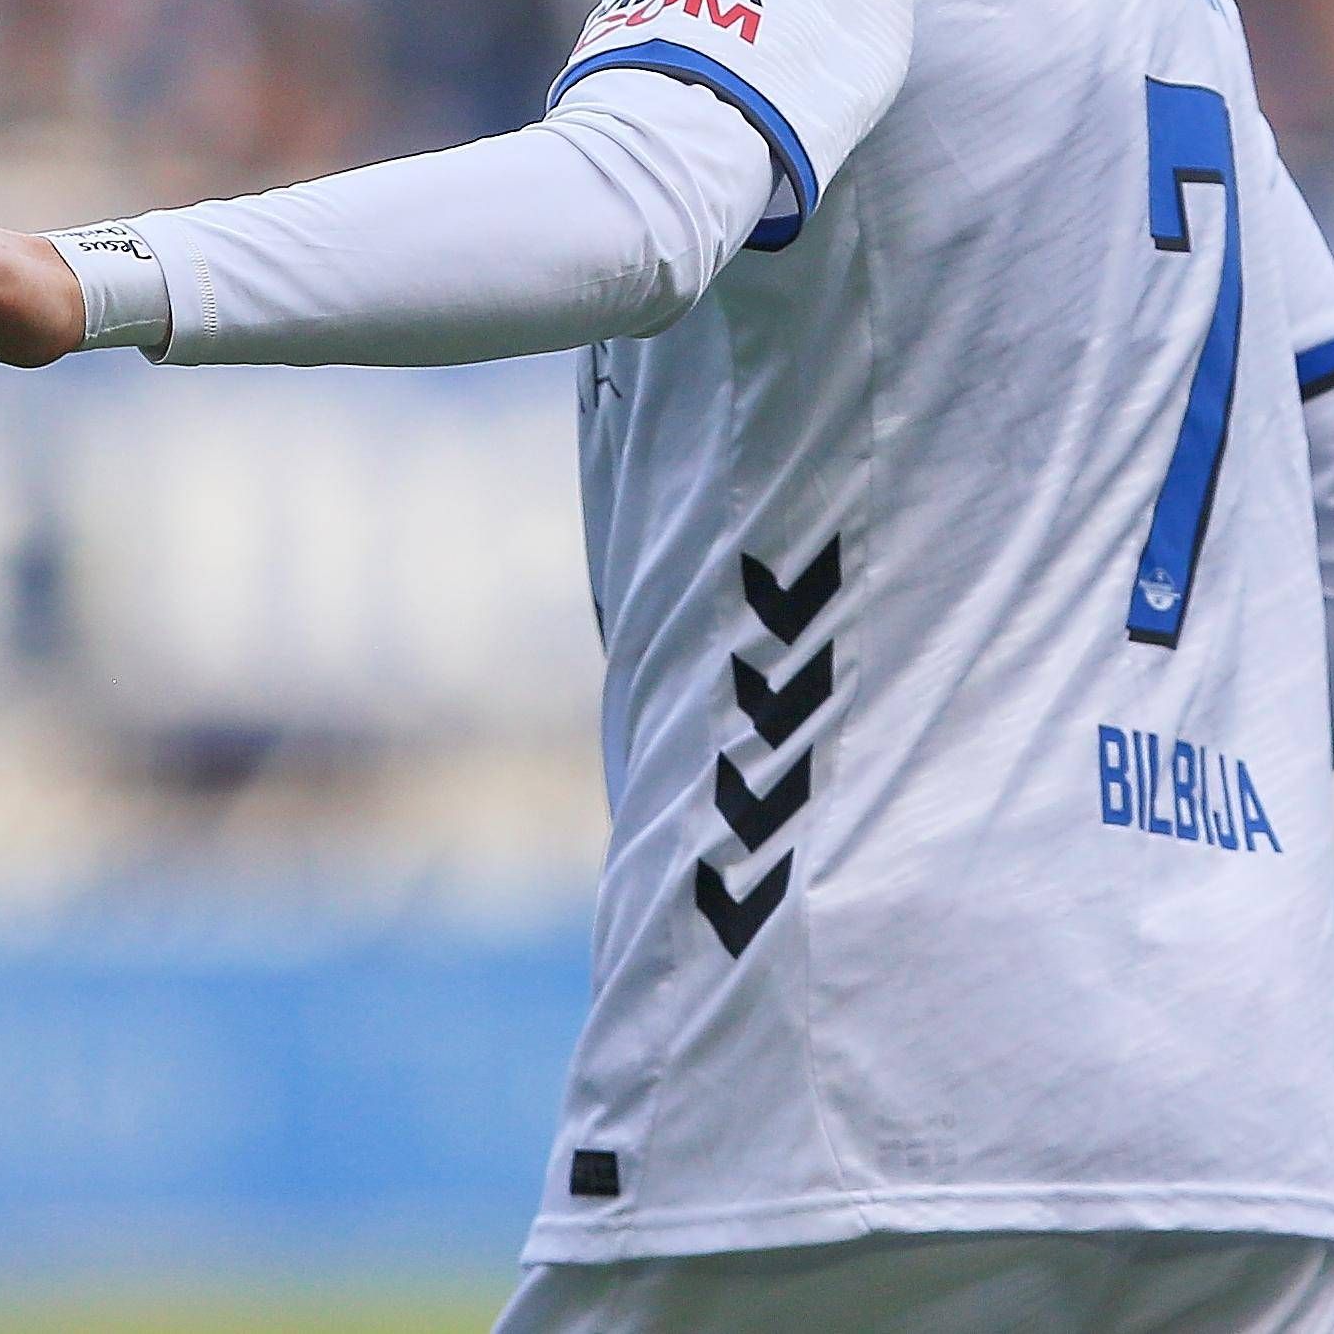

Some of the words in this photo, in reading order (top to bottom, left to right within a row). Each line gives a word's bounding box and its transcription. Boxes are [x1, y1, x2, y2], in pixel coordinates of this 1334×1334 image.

[79, 239, 153, 260] Jesus
[1125, 74, 1243, 649] 7
[1098, 724, 1283, 853] BILBIJA
